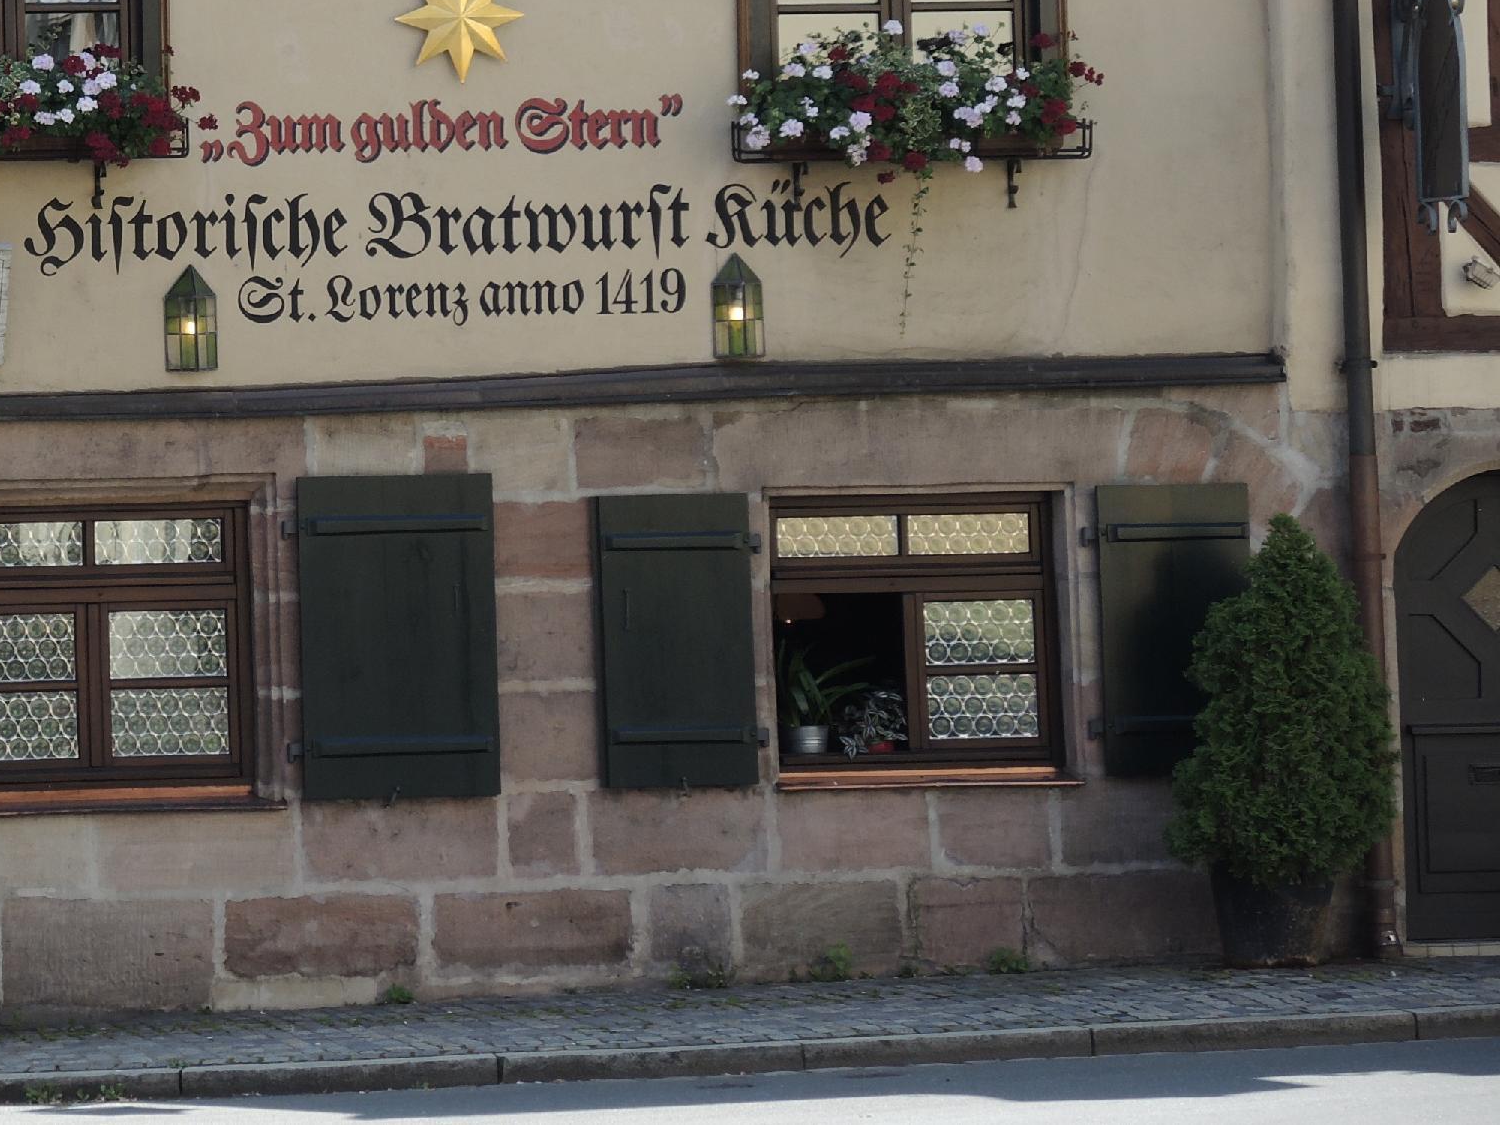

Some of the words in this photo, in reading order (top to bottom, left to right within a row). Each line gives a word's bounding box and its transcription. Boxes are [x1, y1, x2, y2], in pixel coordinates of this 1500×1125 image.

[350, 99, 506, 163] gulden
[705, 179, 892, 259] Küche
[238, 275, 316, 324] St.
[325, 274, 469, 326] Lorenz
[479, 279, 585, 316] anno
[595, 268, 687, 316] 1419
